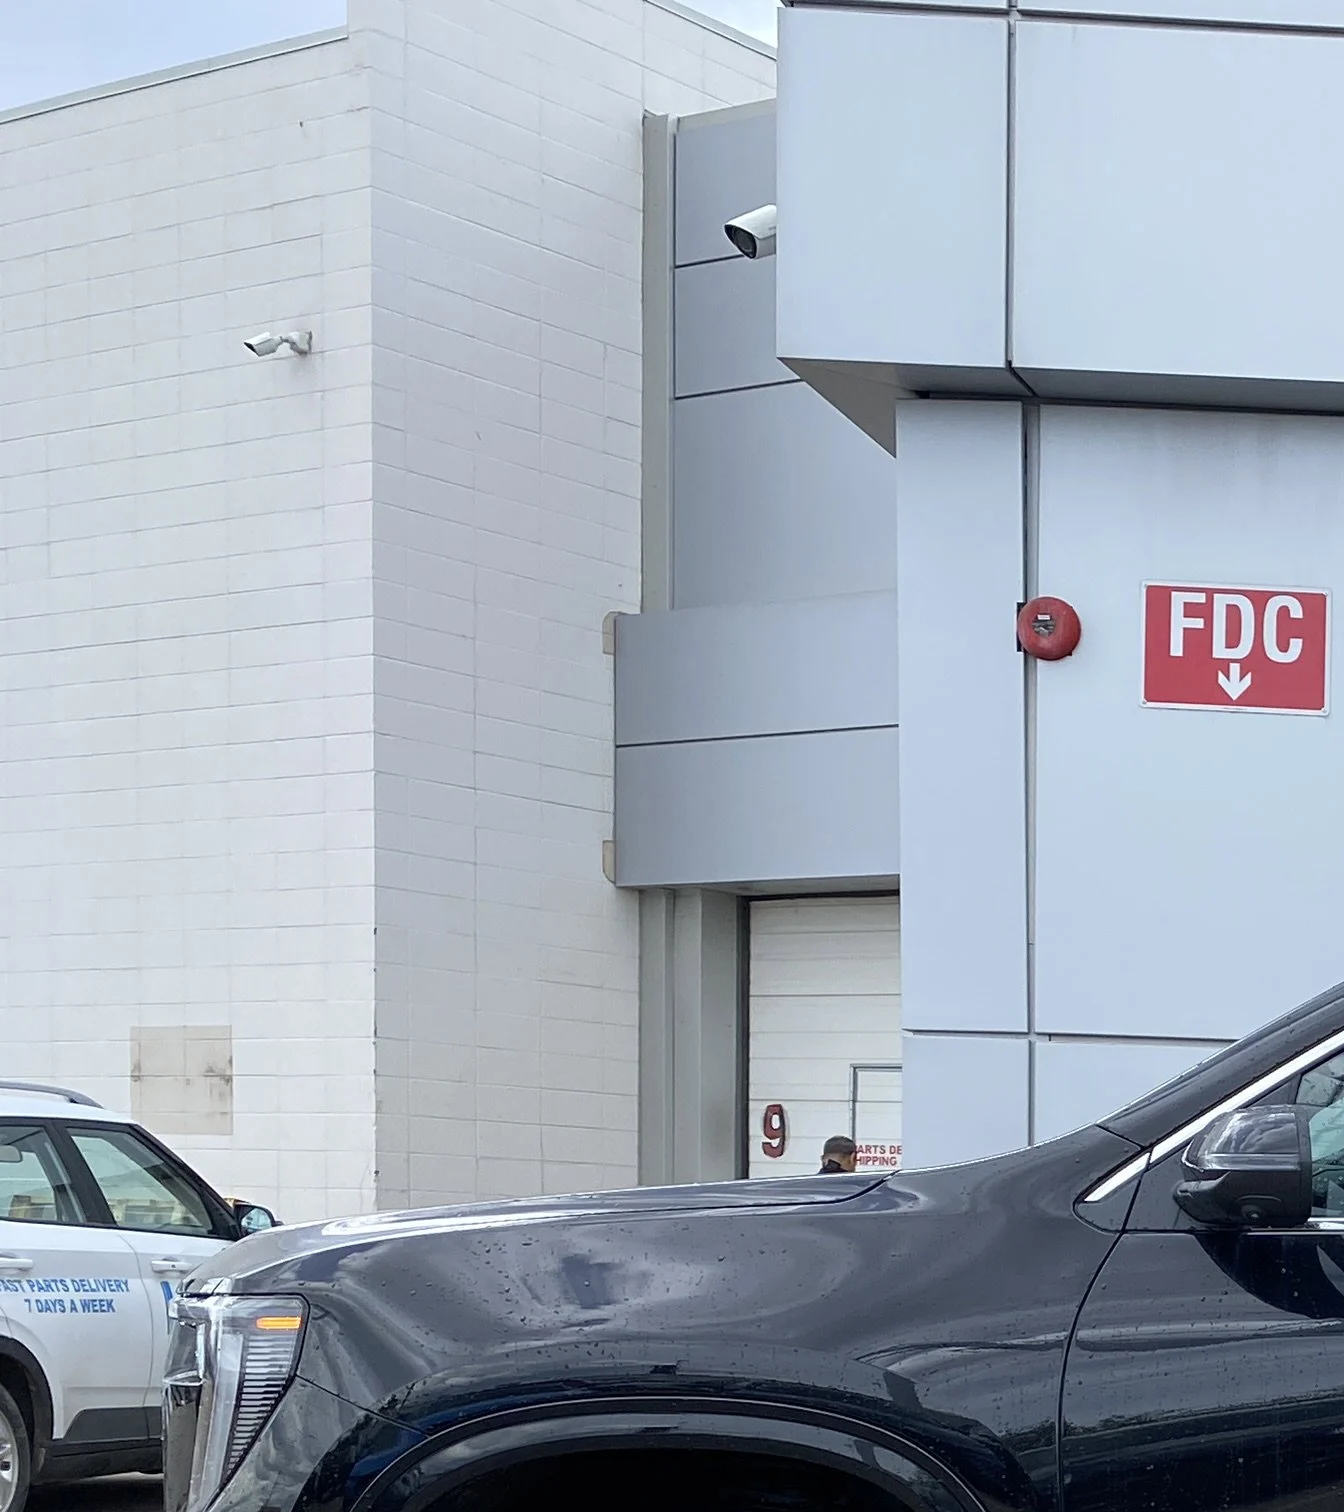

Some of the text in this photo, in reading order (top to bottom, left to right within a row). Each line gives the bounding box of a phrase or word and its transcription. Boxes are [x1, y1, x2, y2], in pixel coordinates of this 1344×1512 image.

[1169, 591, 1304, 664] FDC
[762, 1104, 786, 1158] 9
[855, 1145, 886, 1154] ARTS
[855, 1156, 897, 1166] HIPPING
[0, 1279, 130, 1292] AST PARTS DELIVERY
[24, 1299, 116, 1313] 7 DAYS A WEEK
